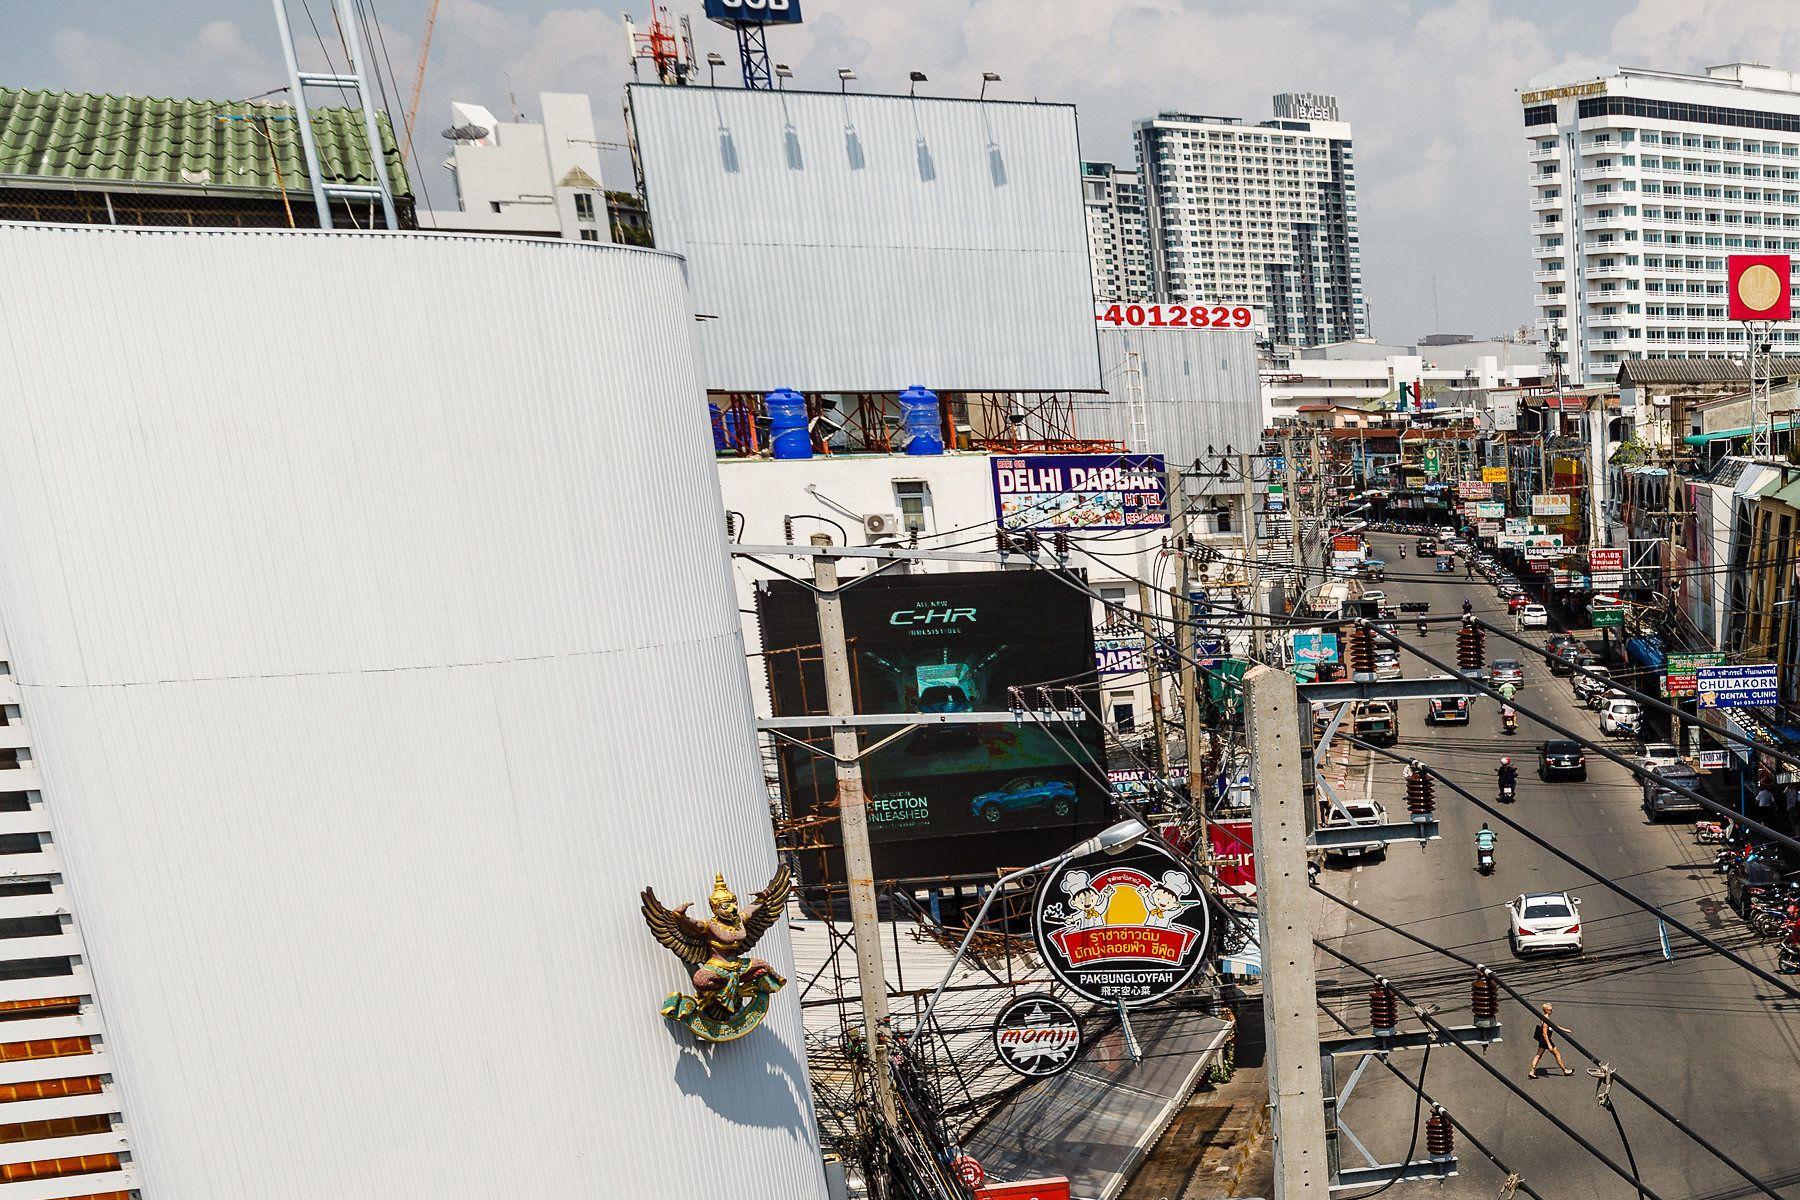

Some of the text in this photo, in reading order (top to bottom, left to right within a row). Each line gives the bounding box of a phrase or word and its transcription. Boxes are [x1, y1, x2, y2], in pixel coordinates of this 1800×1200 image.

[998, 467, 1159, 493] DELHI DARBAR
[889, 607, 977, 625] C-HR
[1699, 678, 1777, 690] CHULAKORN
[1720, 690, 1777, 700] DENTAL CLINIC
[1079, 972, 1173, 985] PAKBUNGLOYFAH
